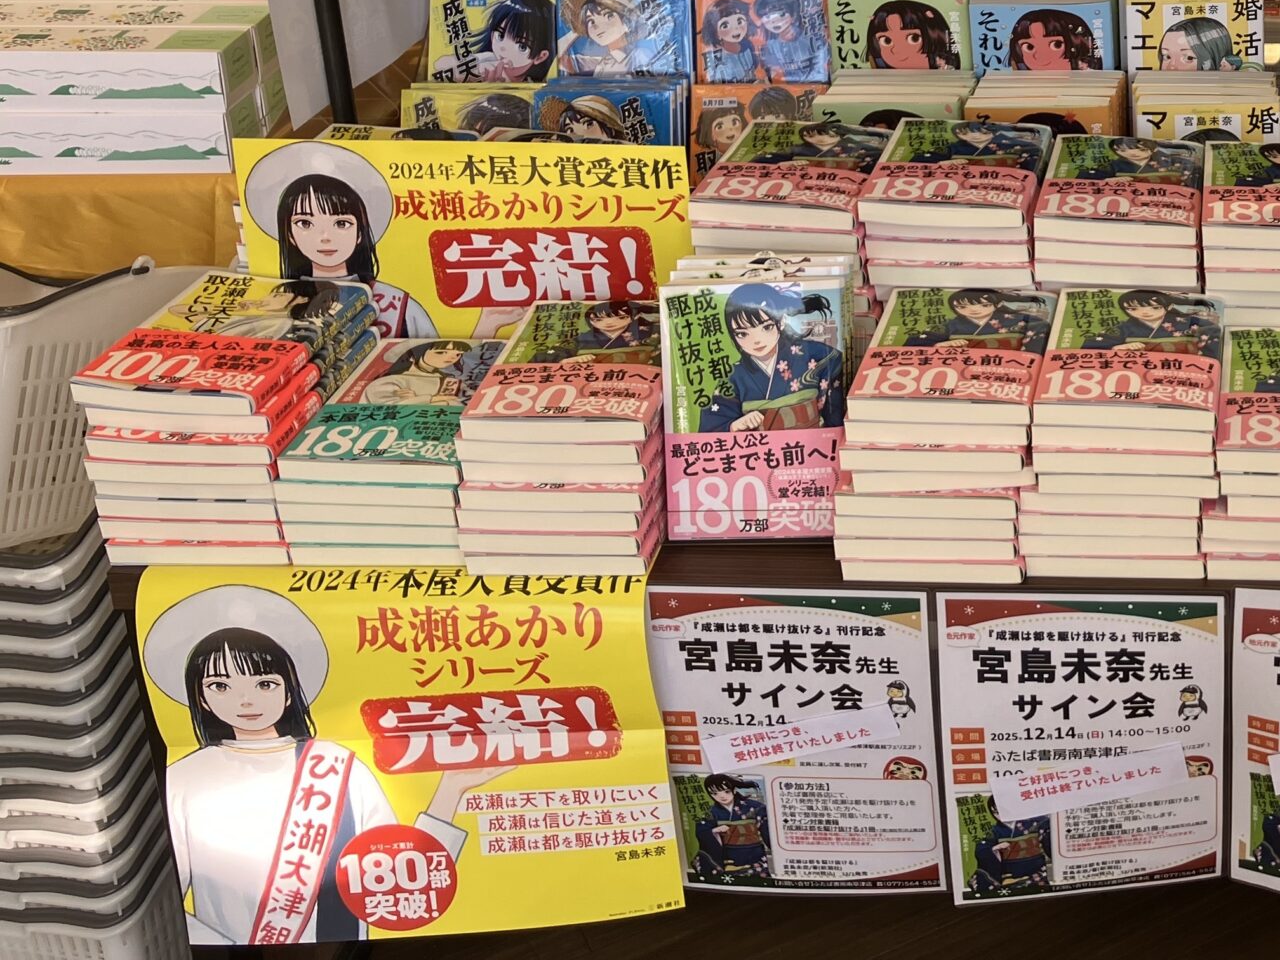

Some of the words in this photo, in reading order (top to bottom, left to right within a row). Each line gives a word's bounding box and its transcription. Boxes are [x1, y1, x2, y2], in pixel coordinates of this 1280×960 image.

[1170, 4, 1219, 16] 宮島未奈
[1183, 115, 1232, 127] 宮島未奈
[388, 153, 685, 191] 2024年本屋大賞受賞作
[721, 170, 869, 187] どこまでも前へ!
[884, 169, 1031, 183] どこまでも前へ!
[392, 189, 687, 224] 成瀬あかりシリーズ
[1054, 186, 1197, 202] どこまでも前へ!
[443, 230, 645, 305] 完結!
[125, 340, 299, 355] 最高の主人公、現る!
[869, 347, 971, 360] 最高の主人公と
[1050, 350, 1149, 362] 最高の主人公と
[492, 363, 594, 379] 最高の主人公と
[877, 354, 1037, 370] どこまでも前へ!
[1059, 357, 1215, 374] どこまでも前へ!
[497, 368, 661, 387] どこまでも前へ!
[670, 433, 770, 460] 最高の主人公と
[681, 439, 838, 477] どこまでも前へ!
[777, 486, 831, 499] 堂々完結!
[355, 601, 605, 655] 成瀬あかり
[692, 622, 832, 637] 『成瀬は都を駆け抜ける』
[836, 625, 886, 638] 刊行記念
[987, 629, 1127, 643] 『成瀬は都を駆け抜ける』
[1132, 631, 1182, 643] 刊行記念
[678, 638, 900, 675] 宮島未奈先生
[971, 646, 1195, 685] 宮島未奈先生
[410, 652, 553, 689] シリーズ
[721, 681, 864, 711] サイン会
[1012, 691, 1156, 722] サイン会
[377, 694, 608, 771] 完結!
[729, 726, 810, 748] ご好評につき、
[733, 726, 872, 762] 受付は終了いたしました
[991, 744, 1130, 763] ふたば書房南草津店
[1017, 765, 1101, 788] ご好評につき、
[1019, 765, 1163, 802] 受付は終了いたしました
[465, 785, 660, 812] 成瀬は天下を取りにいく
[488, 806, 663, 833] 成瀬は信じた道をいく
[487, 825, 666, 854] 成瀬は都を駆け抜ける
[614, 845, 667, 862] 宮島未奈
[339, 850, 451, 894] 180万部
[364, 890, 440, 923] 突破!
